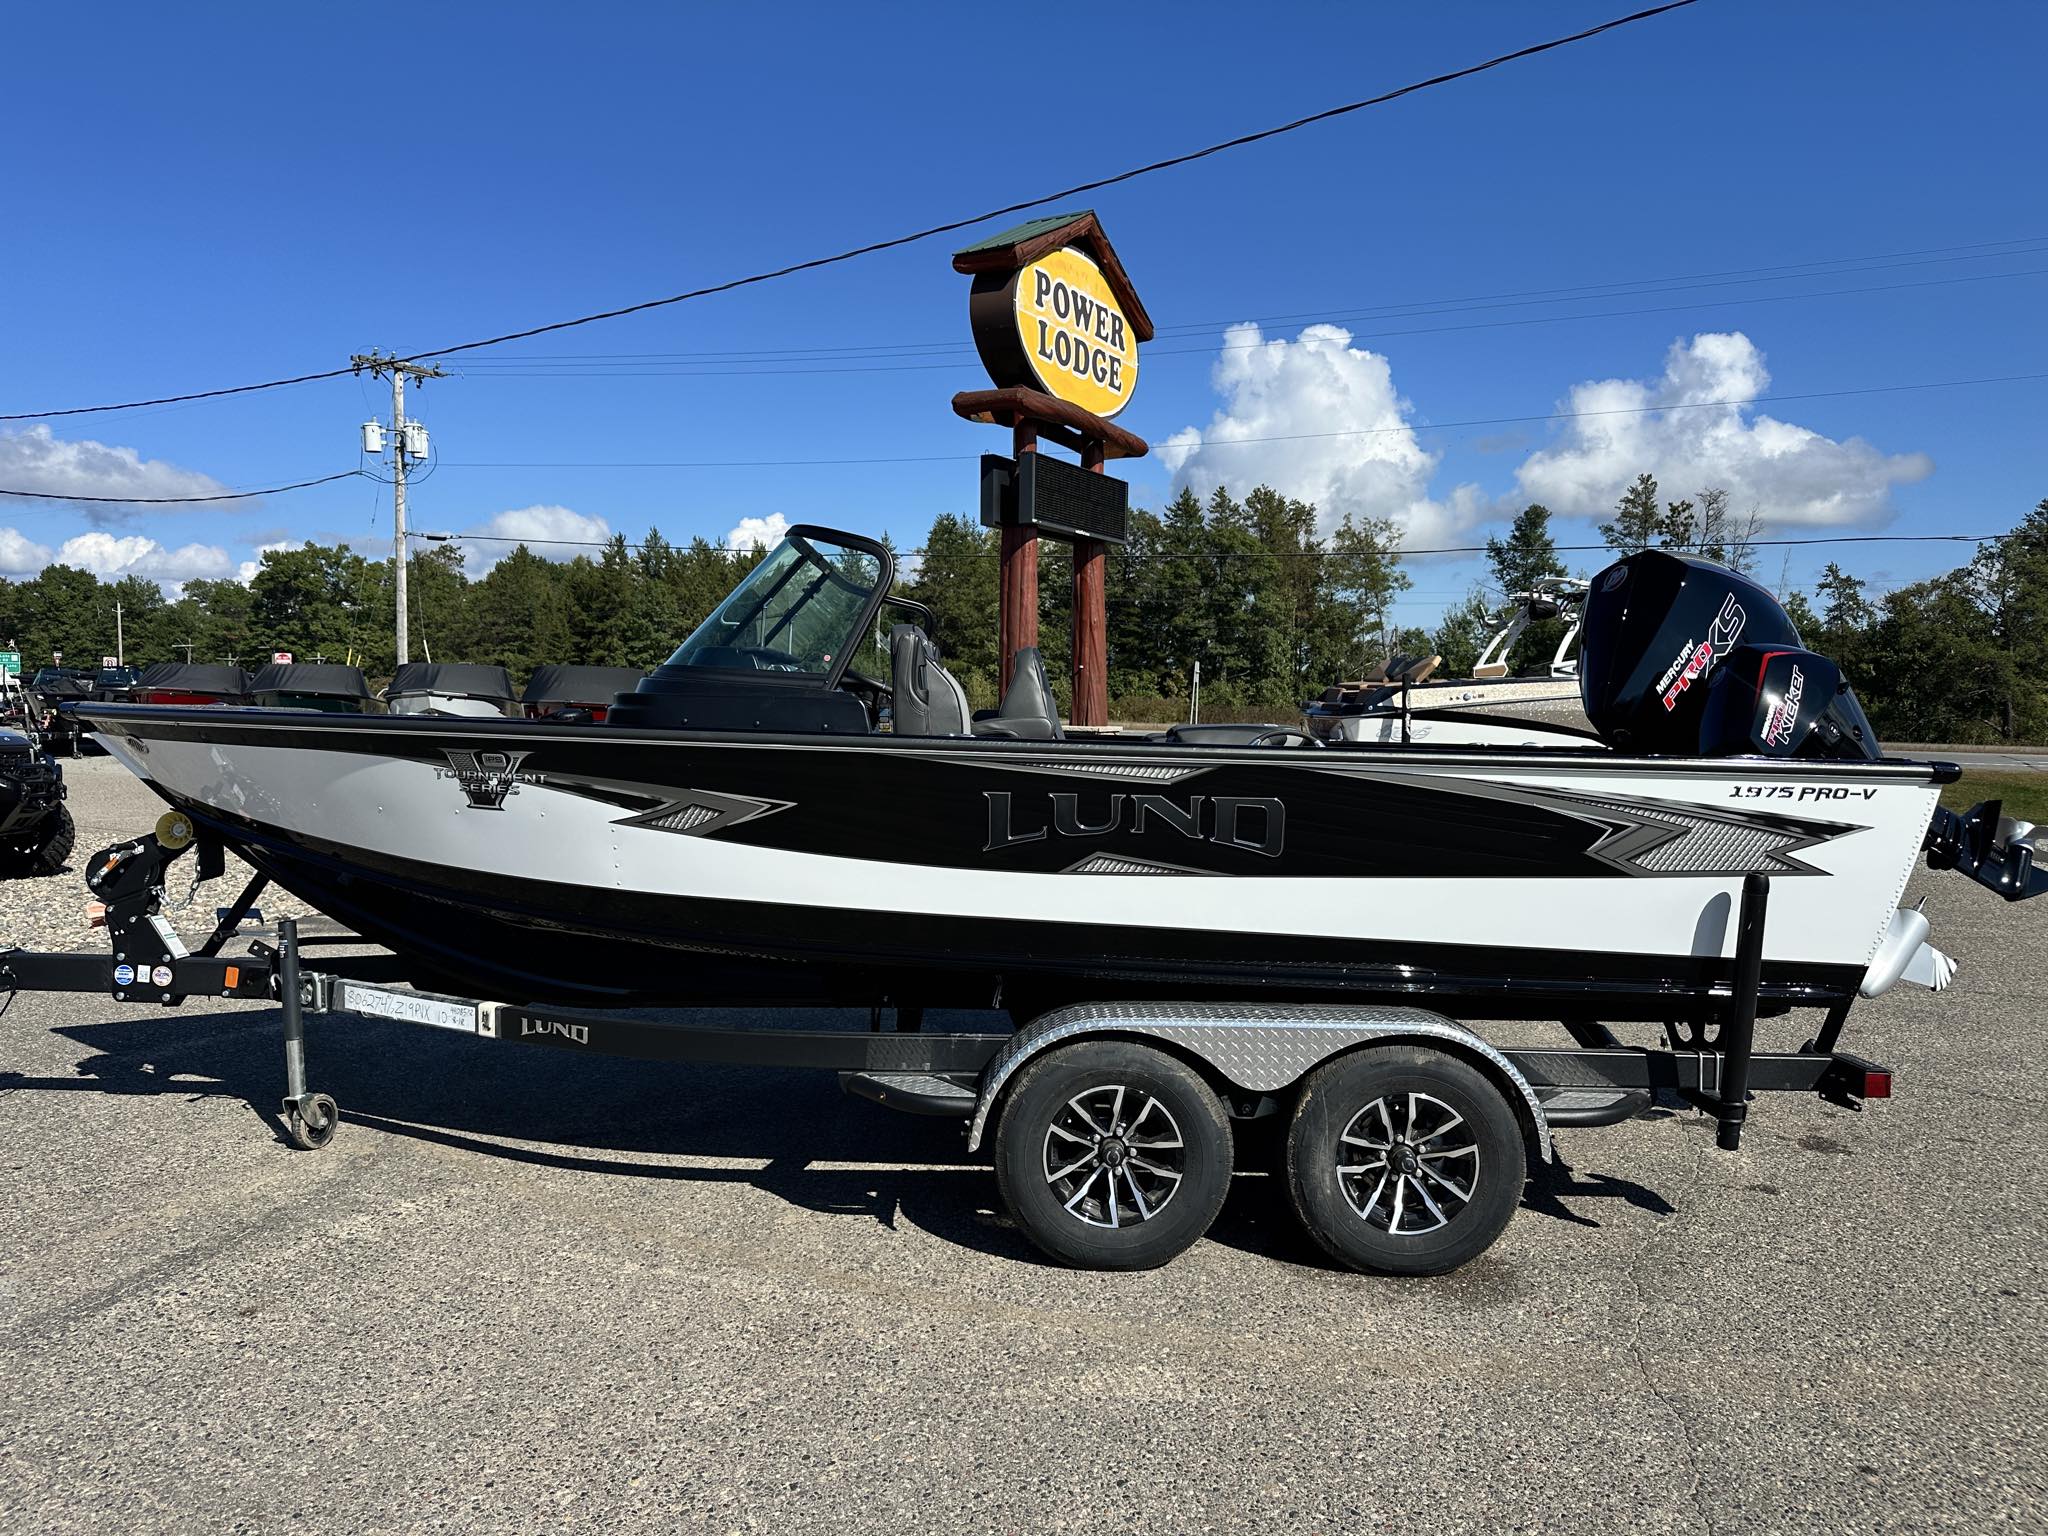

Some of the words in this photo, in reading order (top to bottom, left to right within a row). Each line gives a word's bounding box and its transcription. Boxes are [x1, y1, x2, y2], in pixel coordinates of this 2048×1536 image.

[1035, 269, 1125, 352] POWER
[1038, 319, 1122, 392] LODGE
[1655, 638, 1695, 695] MERCURY
[1662, 640, 1713, 712] PRO
[1705, 592, 1746, 678] XS
[433, 767, 548, 784] TOURNAMENT
[459, 782, 521, 796] SERIES
[1729, 785, 1796, 798] 1975
[1797, 786, 1878, 801] PRO-V
[983, 791, 1286, 857] LUND
[520, 1017, 589, 1045] LUND
